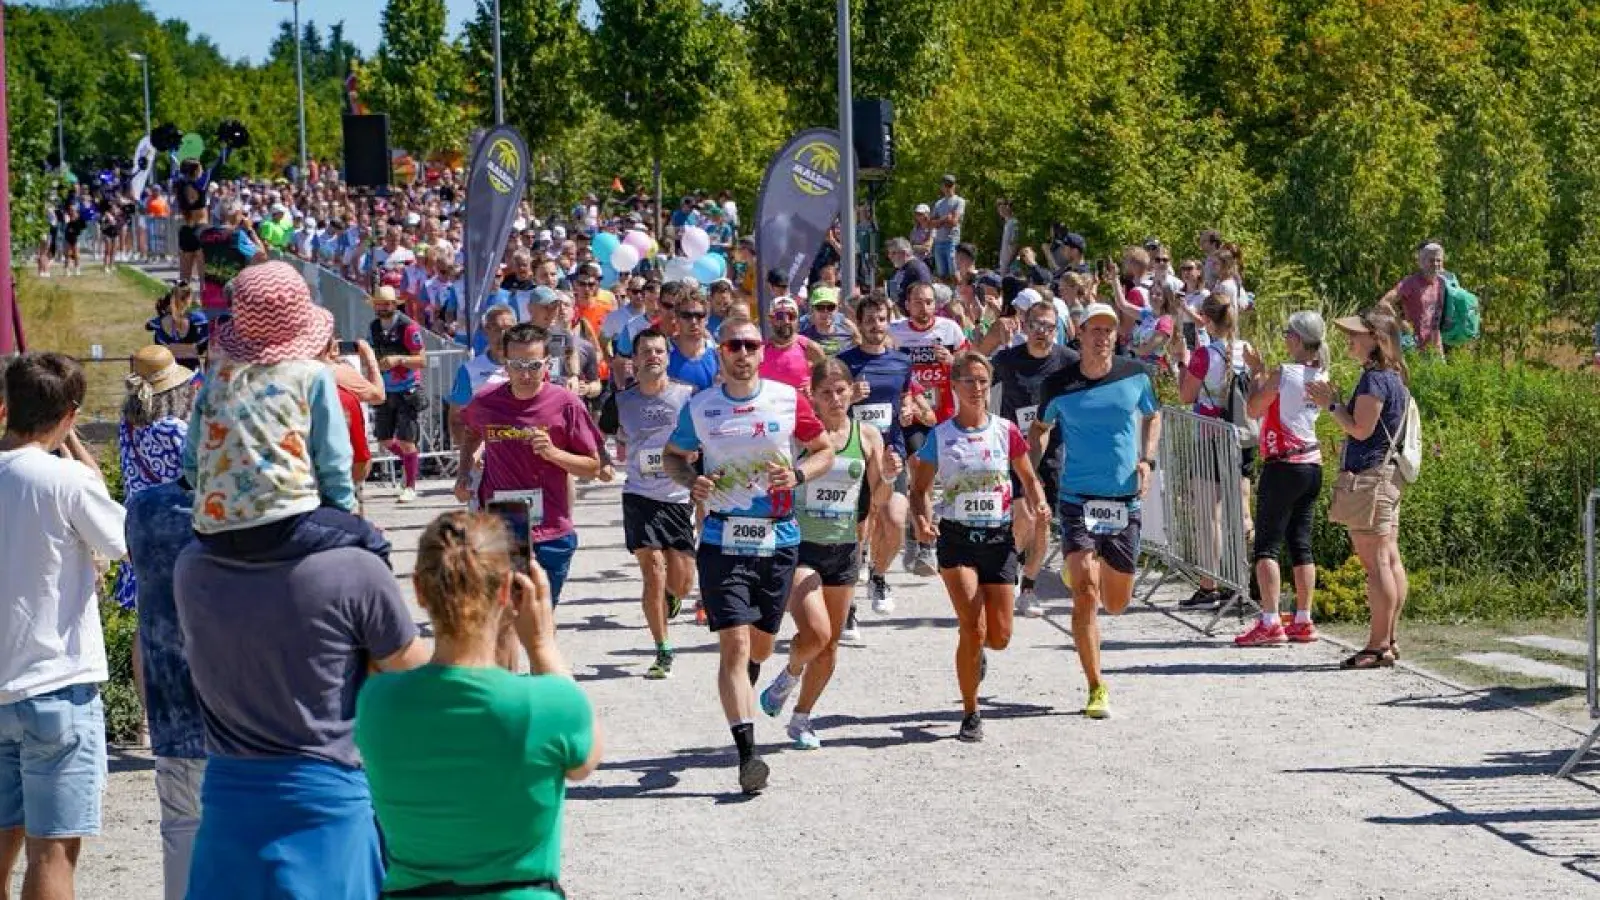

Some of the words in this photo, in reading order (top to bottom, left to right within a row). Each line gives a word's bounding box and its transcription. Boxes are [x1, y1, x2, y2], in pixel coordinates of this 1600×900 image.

[647, 454, 661, 466] 30
[816, 488, 848, 503] 2307
[964, 499, 995, 511] 2106
[1089, 508, 1121, 521] 400-1
[732, 524, 767, 539] 2068
